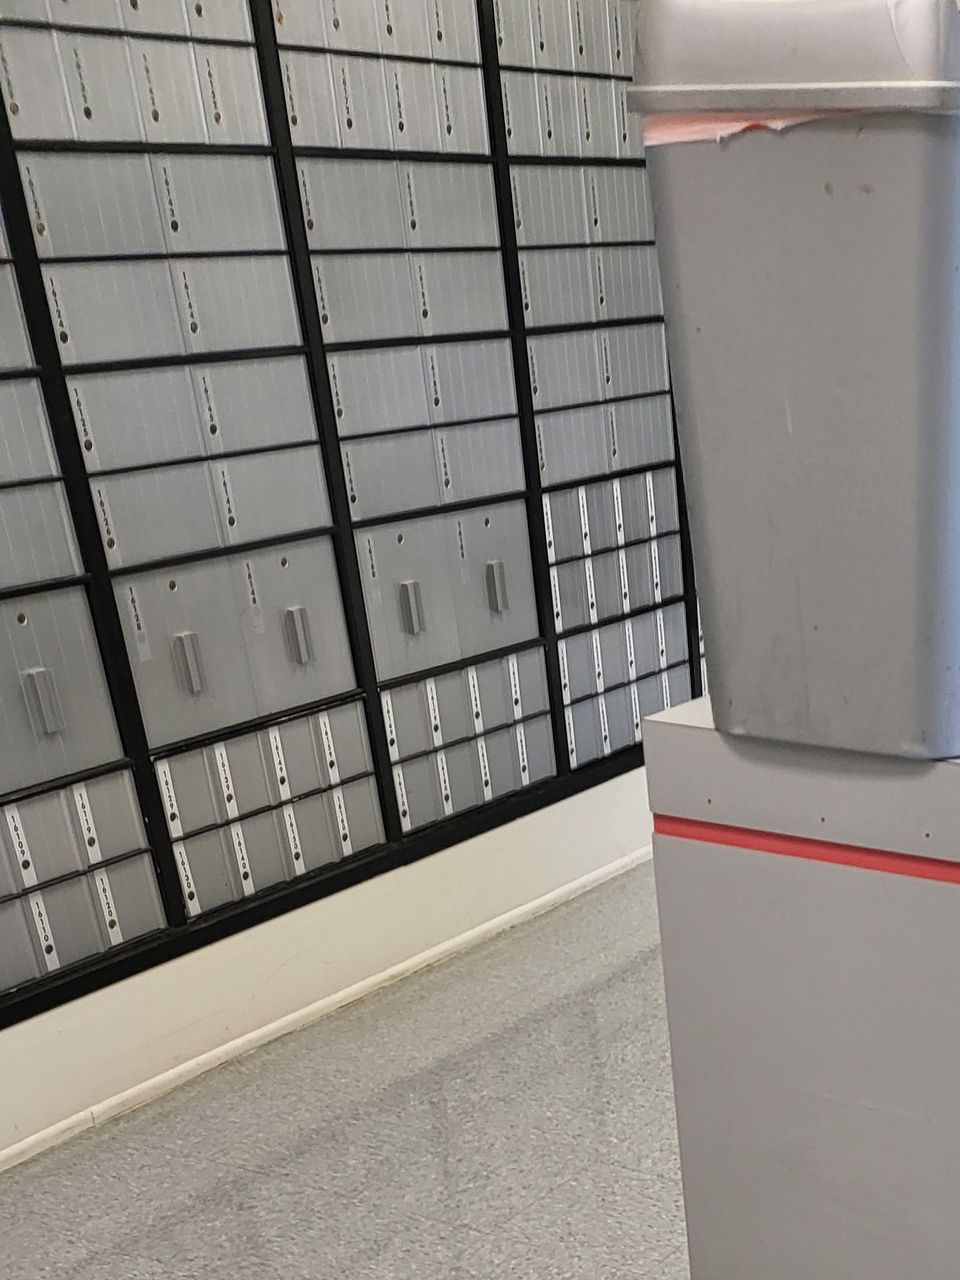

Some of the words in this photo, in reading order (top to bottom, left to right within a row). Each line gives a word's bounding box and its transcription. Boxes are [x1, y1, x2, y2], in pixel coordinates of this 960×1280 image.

[49, 277, 65, 329] 16124
[73, 387, 89, 438] 16125
[162, 770, 174, 811] 16129
[219, 752, 230, 792] 16139
[78, 792, 92, 835] 16119
[11, 815, 26, 858] 16109
[236, 831, 247, 870] 16140
[178, 851, 192, 889] 16130
[99, 877, 113, 918] 16120
[35, 901, 50, 943] 16110
